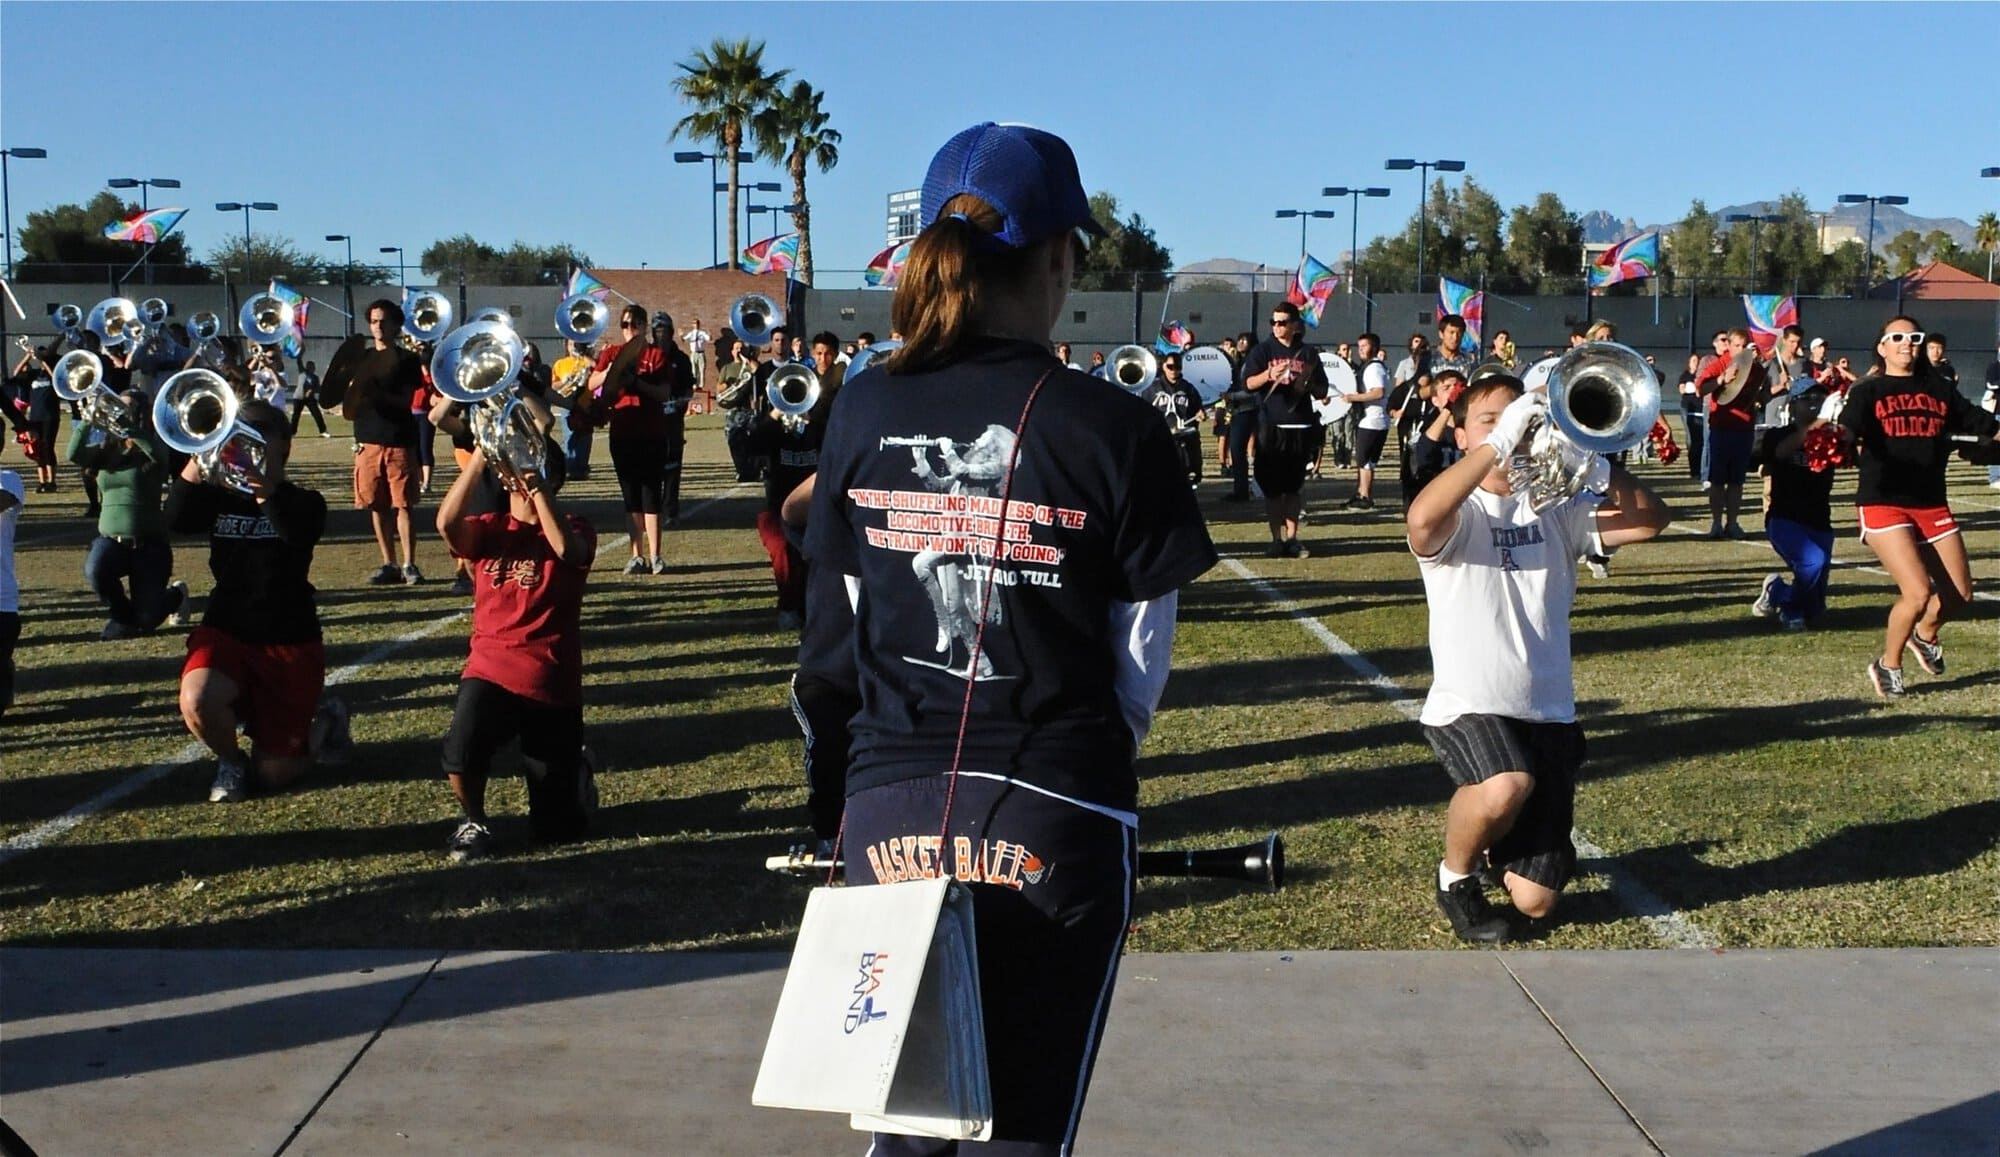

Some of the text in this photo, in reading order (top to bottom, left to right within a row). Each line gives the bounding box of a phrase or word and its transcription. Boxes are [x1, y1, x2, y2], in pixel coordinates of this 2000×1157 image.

[1875, 393, 1947, 419] ARIZONA
[1881, 416, 1945, 437] WILDCAT
[867, 489, 890, 509] THE
[890, 491, 967, 514] SHUFFLING
[968, 495, 1036, 522] MADESS
[1036, 504, 1056, 526] OF
[1057, 508, 1087, 529] THE
[887, 510, 1032, 544] LOCOMOTIVE BRETH,
[1491, 525, 1545, 548] IZONA
[865, 526, 887, 549] THE
[886, 531, 928, 553] TRAIN
[927, 535, 979, 556] WON'T
[979, 537, 1011, 561] STP
[1020, 570, 1062, 588] TULL
[843, 952, 877, 1035] BAND
